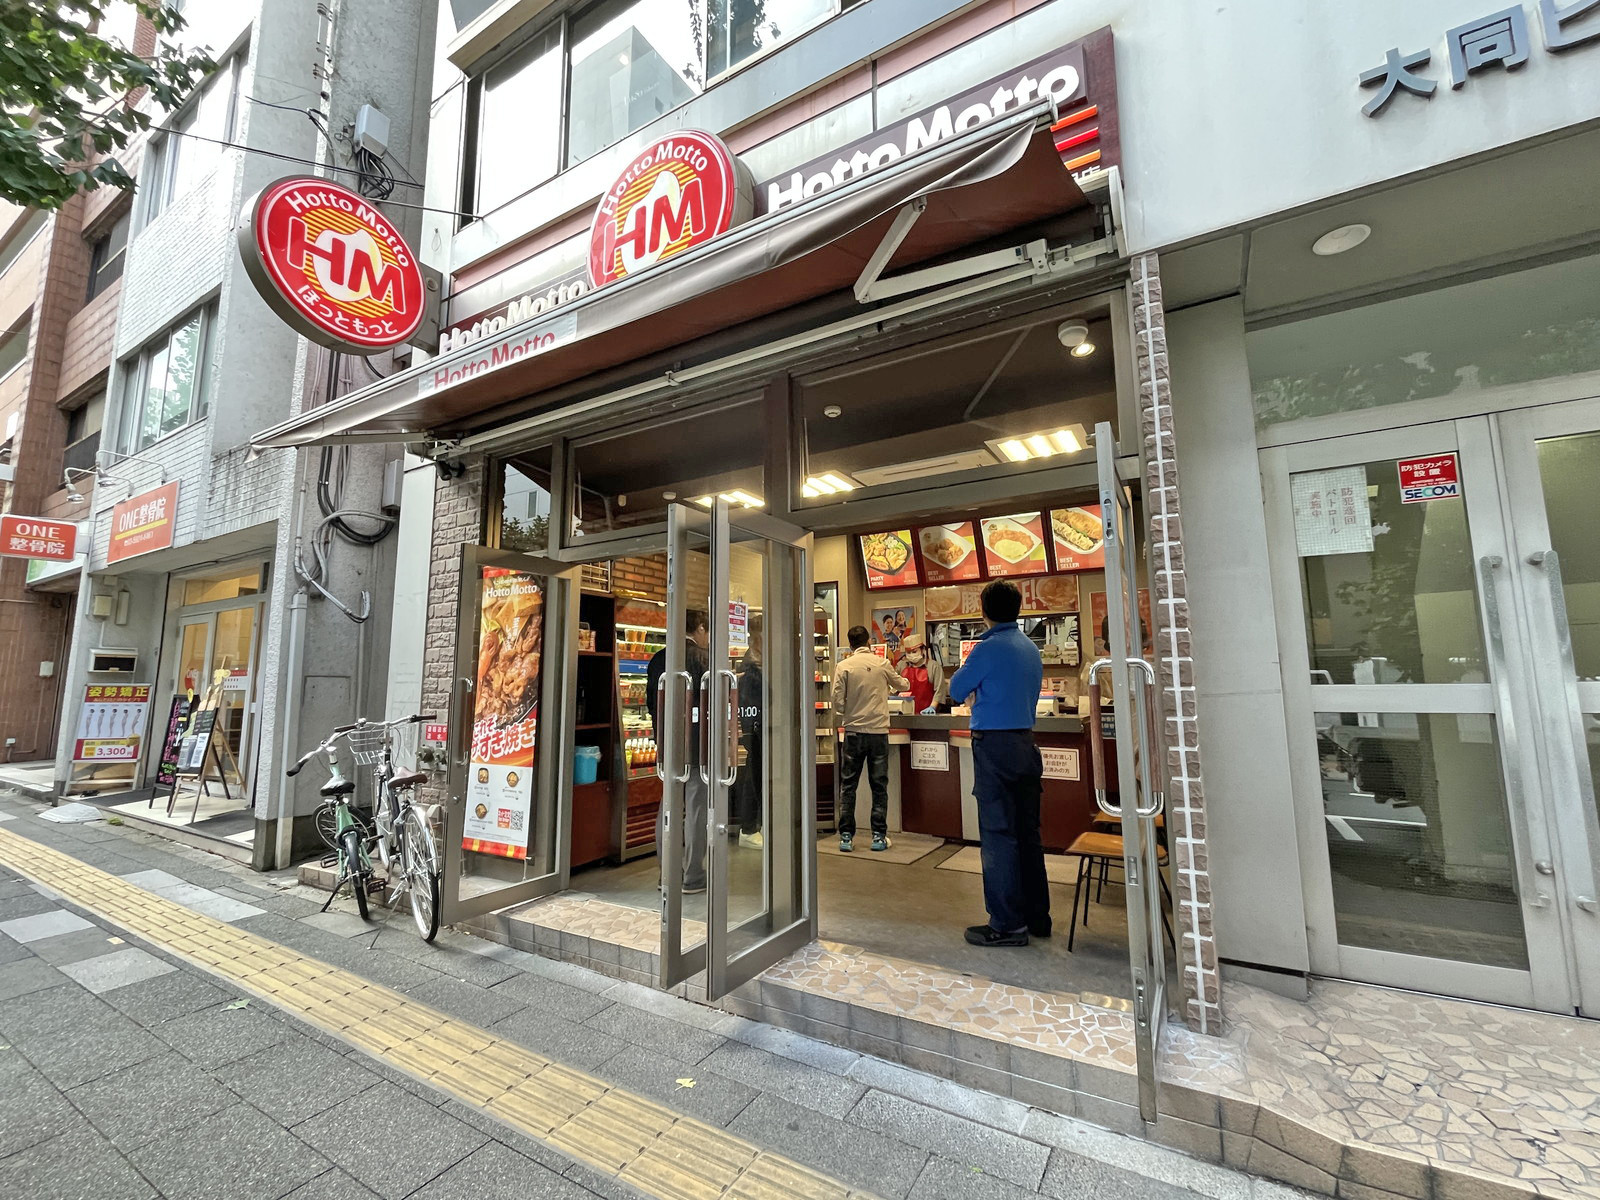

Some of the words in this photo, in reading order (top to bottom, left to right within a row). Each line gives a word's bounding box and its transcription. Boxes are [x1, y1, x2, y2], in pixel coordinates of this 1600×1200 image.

[285, 190, 354, 213] Hotto
[355, 205, 410, 268] Motto
[287, 216, 406, 315] HM
[296, 284, 398, 336] ほっともっと
[1401, 460, 1452, 472] 防犯カメラ
[1405, 485, 1456, 499] SECOM
[1326, 489, 1341, 534] パトロール
[16, 523, 61, 540] ONE
[9, 537, 65, 555] 整骨院
[88, 686, 148, 697] 姿勢矯正
